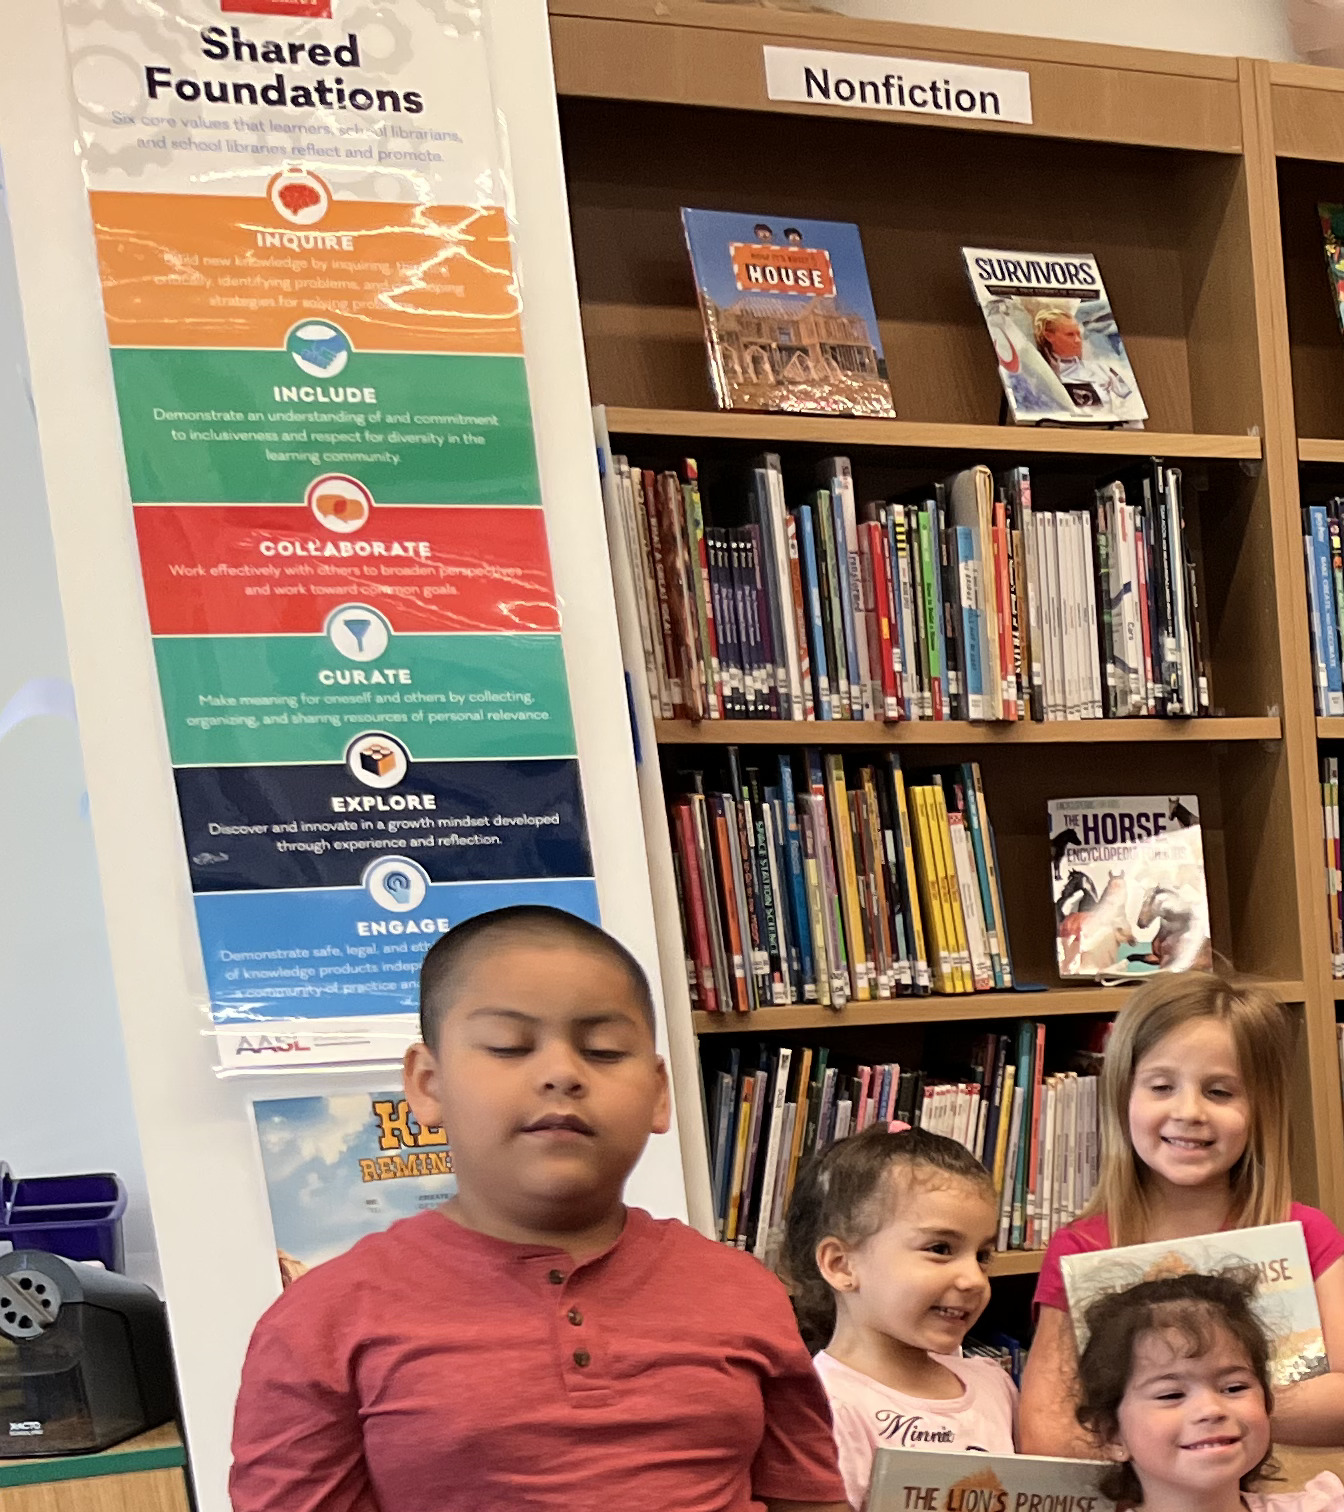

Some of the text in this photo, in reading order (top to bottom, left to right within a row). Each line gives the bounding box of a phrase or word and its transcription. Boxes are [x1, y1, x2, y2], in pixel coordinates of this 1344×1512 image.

[200, 26, 360, 68] Shared
[144, 65, 424, 114] Foundations
[802, 65, 1000, 116] Nonfiction
[180, 117, 230, 131] values
[232, 118, 266, 132] that
[137, 137, 373, 160] and school reflect and
[256, 232, 355, 251] INQUIRE
[746, 263, 824, 288] HOUSE
[975, 257, 1096, 285] SURVIVORS
[273, 385, 377, 403] INCLUDE
[153, 408, 499, 427] Demonstrate an understanding of and commitment
[171, 428, 486, 447] to inclusiveness and respect for diversity in the
[265, 449, 320, 465] learning
[259, 540, 432, 559] COLLABORATE
[169, 563, 436, 579] Work effectively with others to broaden
[244, 583, 271, 595] and
[274, 583, 307, 595] work
[310, 583, 358, 595] toward
[849, 551, 861, 613] Transformed
[318, 669, 412, 686] CURATE
[199, 693, 238, 706] Make
[241, 694, 298, 709] meaning
[300, 693, 322, 706] for
[324, 691, 373, 705] oneself
[376, 692, 401, 704] and
[404, 692, 447, 704] others
[449, 691, 466, 707] by
[263, 712, 289, 726] and
[291, 711, 340, 729] sharing
[343, 711, 408, 723] resources
[411, 709, 425, 722] of
[428, 708, 485, 725] personal
[331, 794, 437, 814] EXPLORE
[209, 813, 559, 836] Discover and innovate in a growth mindset developed
[1064, 813, 1168, 845] THE HORSE
[276, 833, 503, 854] through experience and reflection.
[356, 918, 450, 937] ENGAGE
[220, 948, 309, 962] Demonstrate
[384, 942, 409, 954] and
[243, 963, 317, 979] knowledge
[320, 961, 379, 978] products
[903, 1486, 940, 1511] THE
